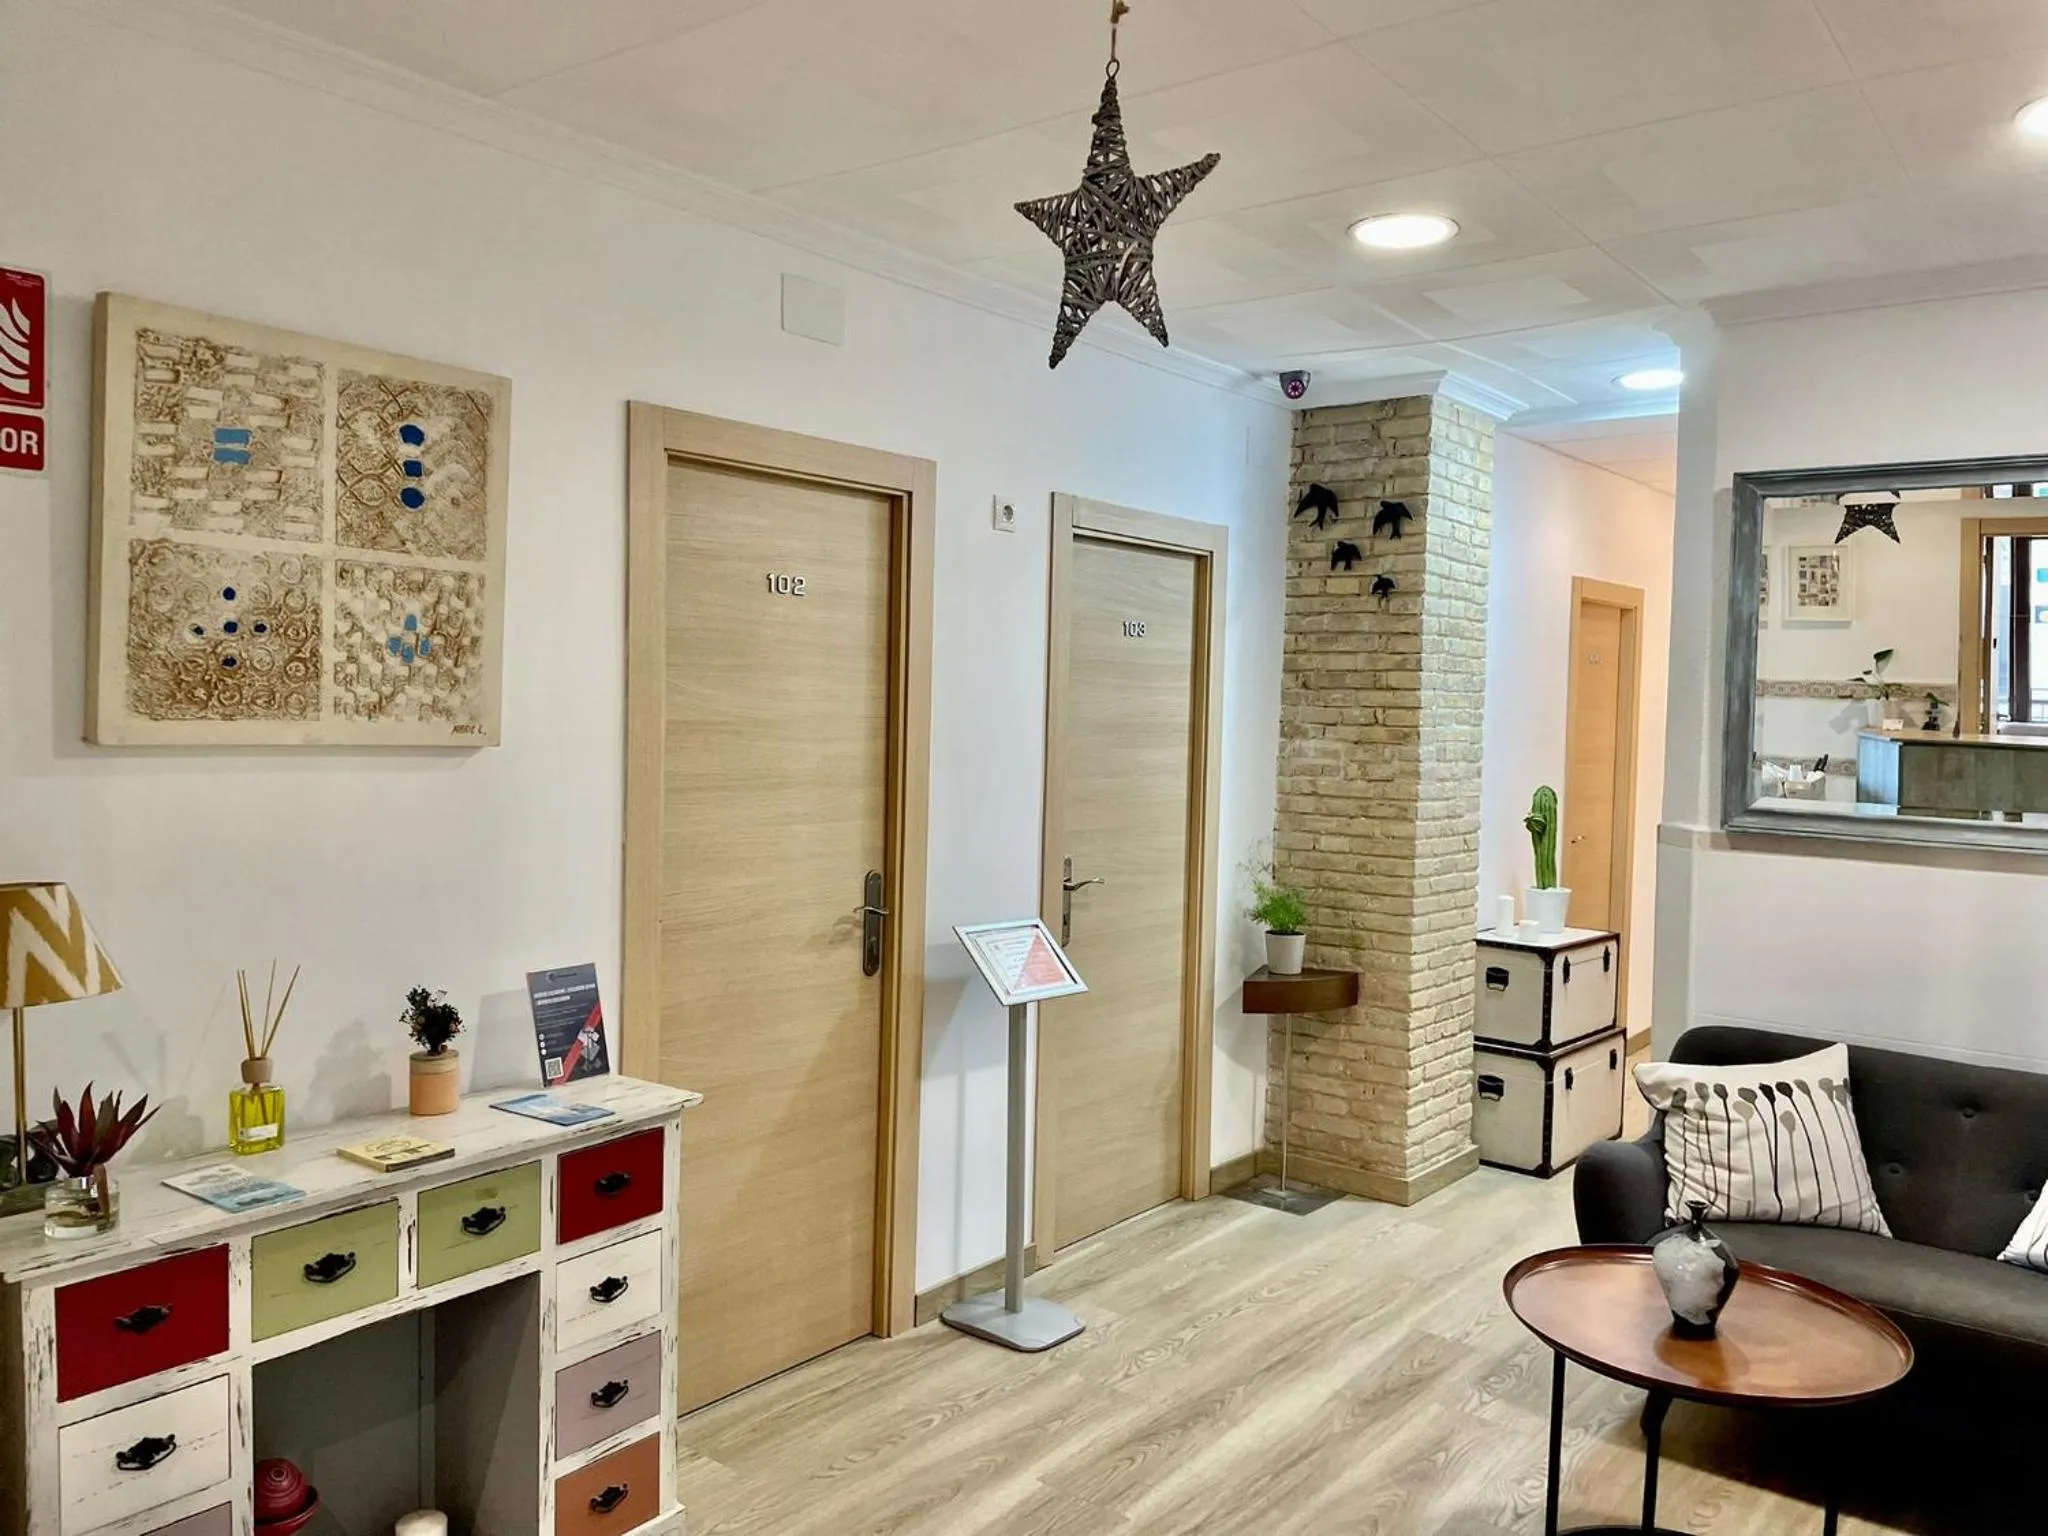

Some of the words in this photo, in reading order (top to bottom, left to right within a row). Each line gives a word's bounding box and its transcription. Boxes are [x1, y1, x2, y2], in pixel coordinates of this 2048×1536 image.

[1, 427, 38, 455] OR
[766, 573, 806, 597] 102
[1123, 621, 1146, 638] 103
